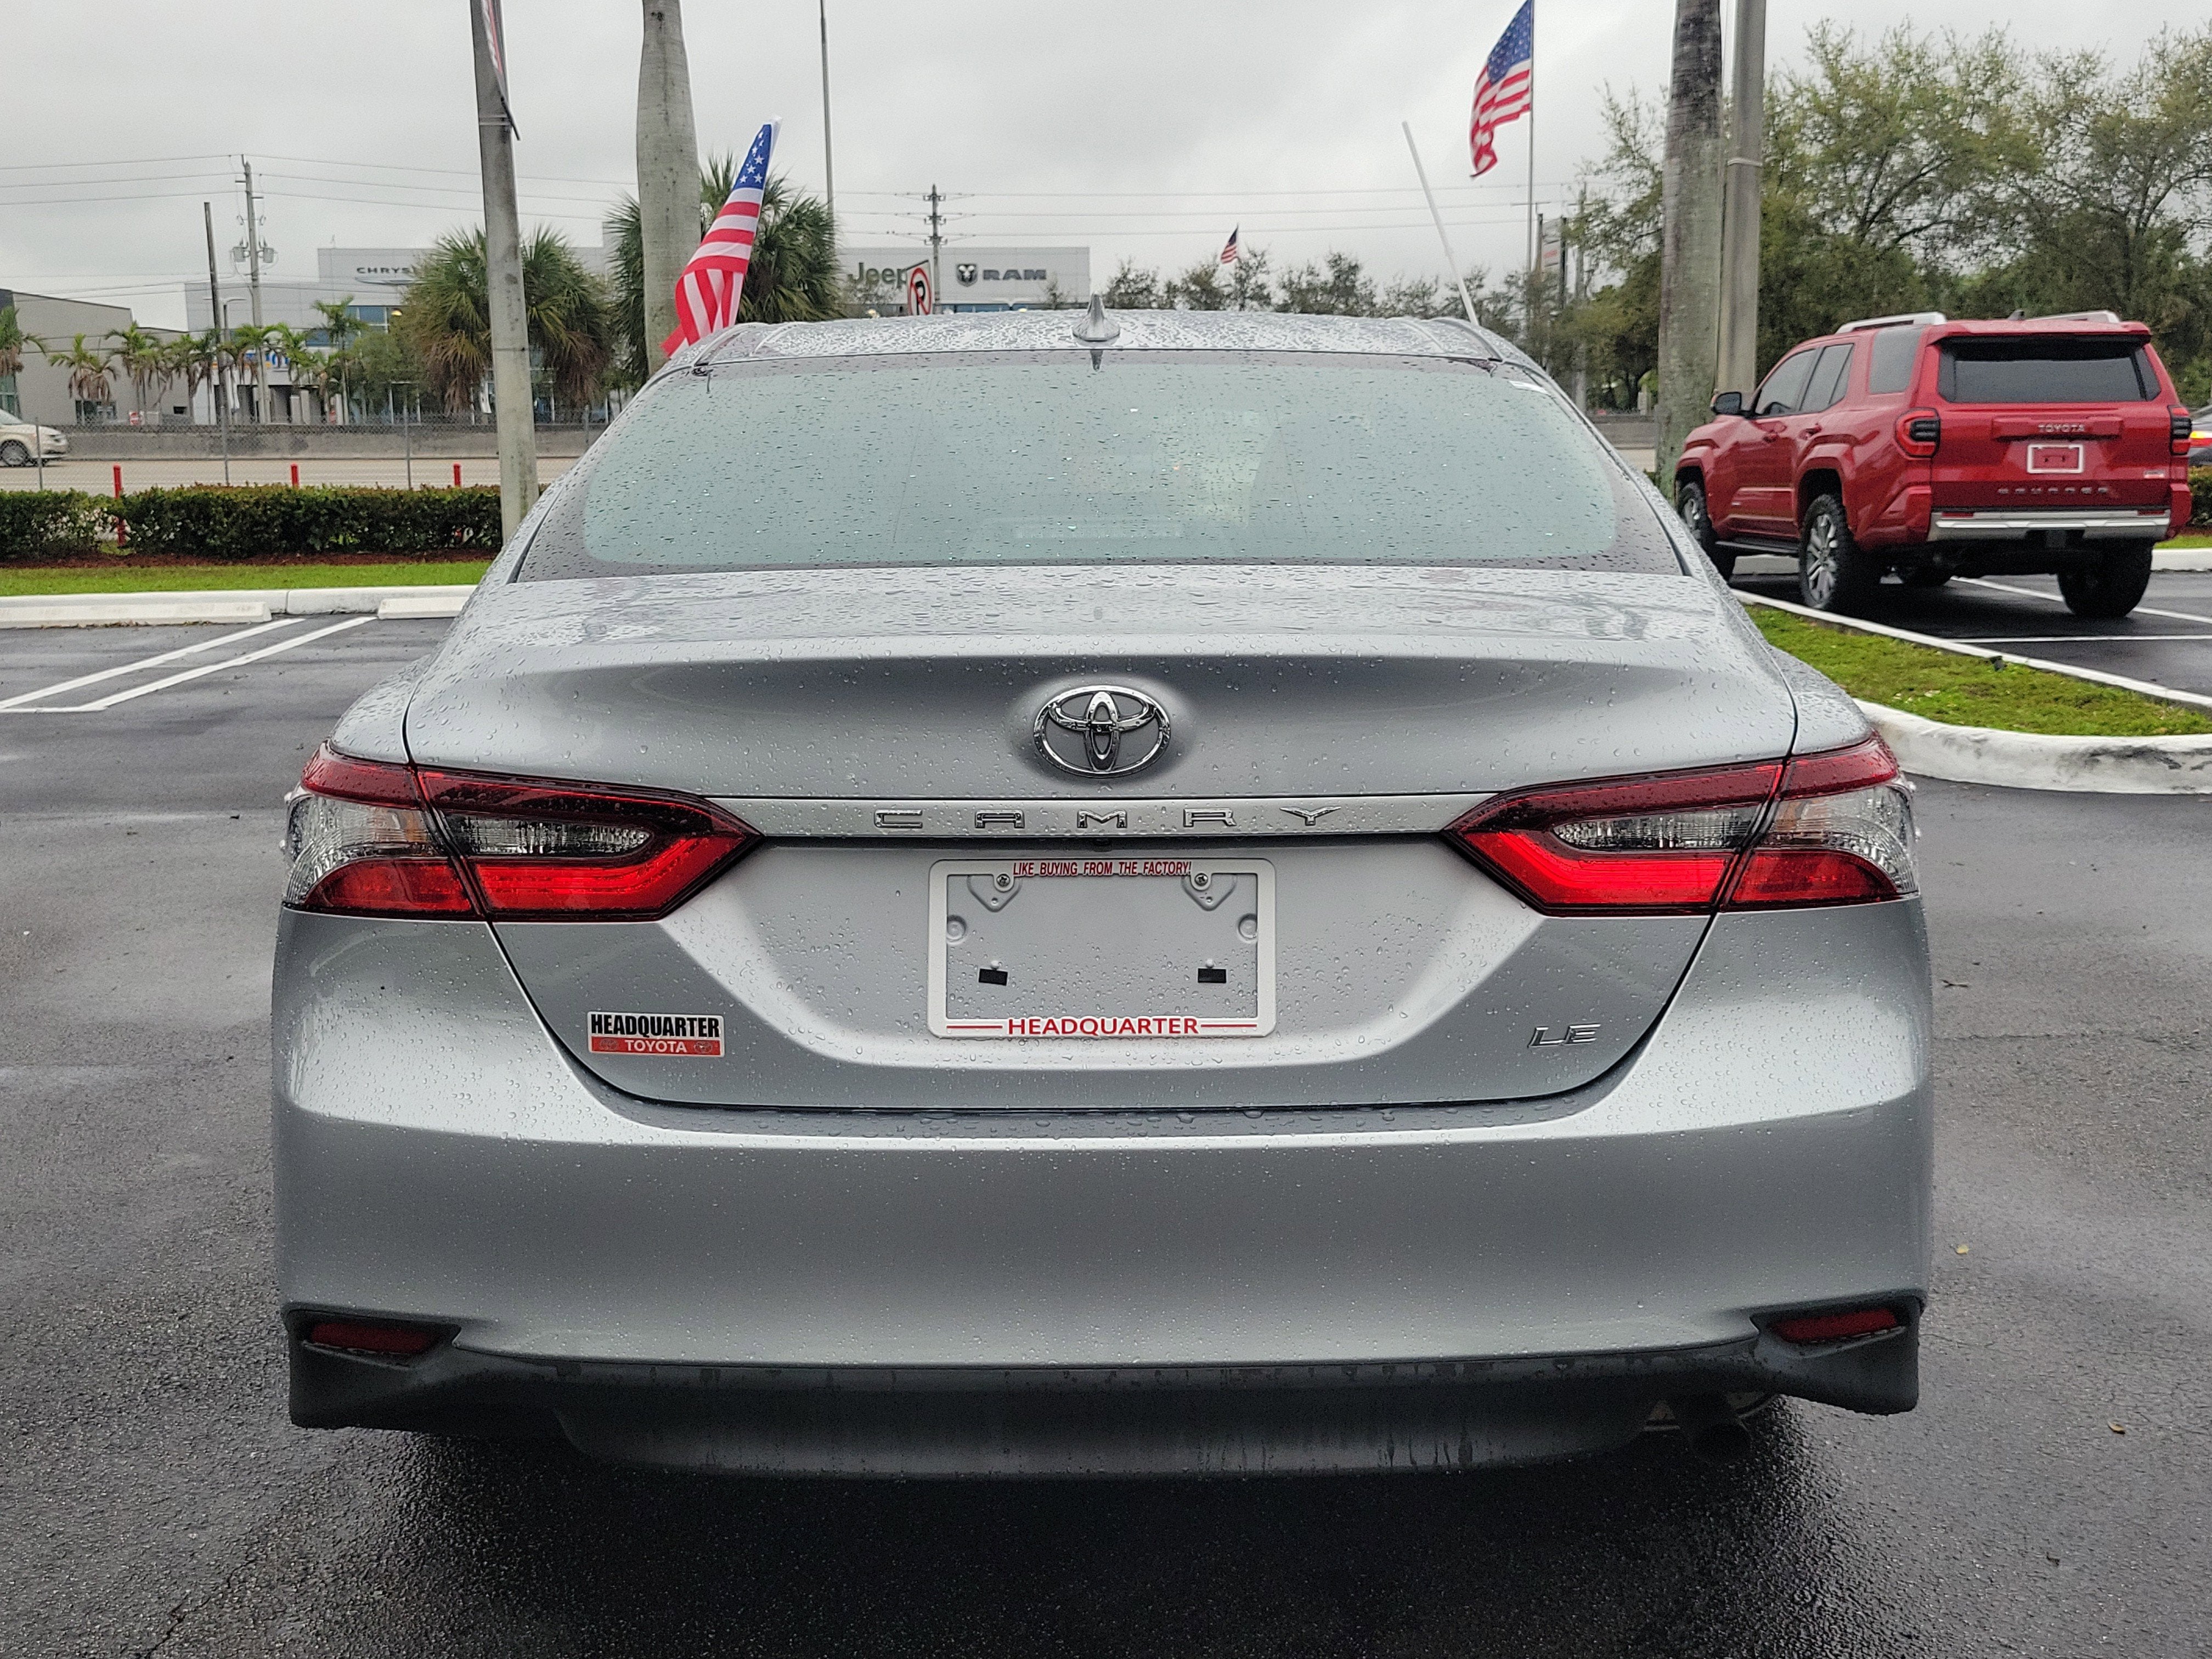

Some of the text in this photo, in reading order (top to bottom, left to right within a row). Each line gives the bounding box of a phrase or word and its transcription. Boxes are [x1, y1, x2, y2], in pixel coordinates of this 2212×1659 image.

[847, 262, 907, 289] Jeep
[983, 269, 1047, 280] RAM
[2038, 424, 2085, 433] TOYOTA
[874, 806, 1342, 829] CAMRY
[1013, 861, 1192, 876] LIKE BUYING FROM THE FACTORY!
[590, 1014, 720, 1038] HEADQUARTER
[1008, 1018, 1199, 1036] HEADQUARTER
[1527, 1022, 1601, 1048] LE
[624, 1039, 688, 1053] TOYOTA
